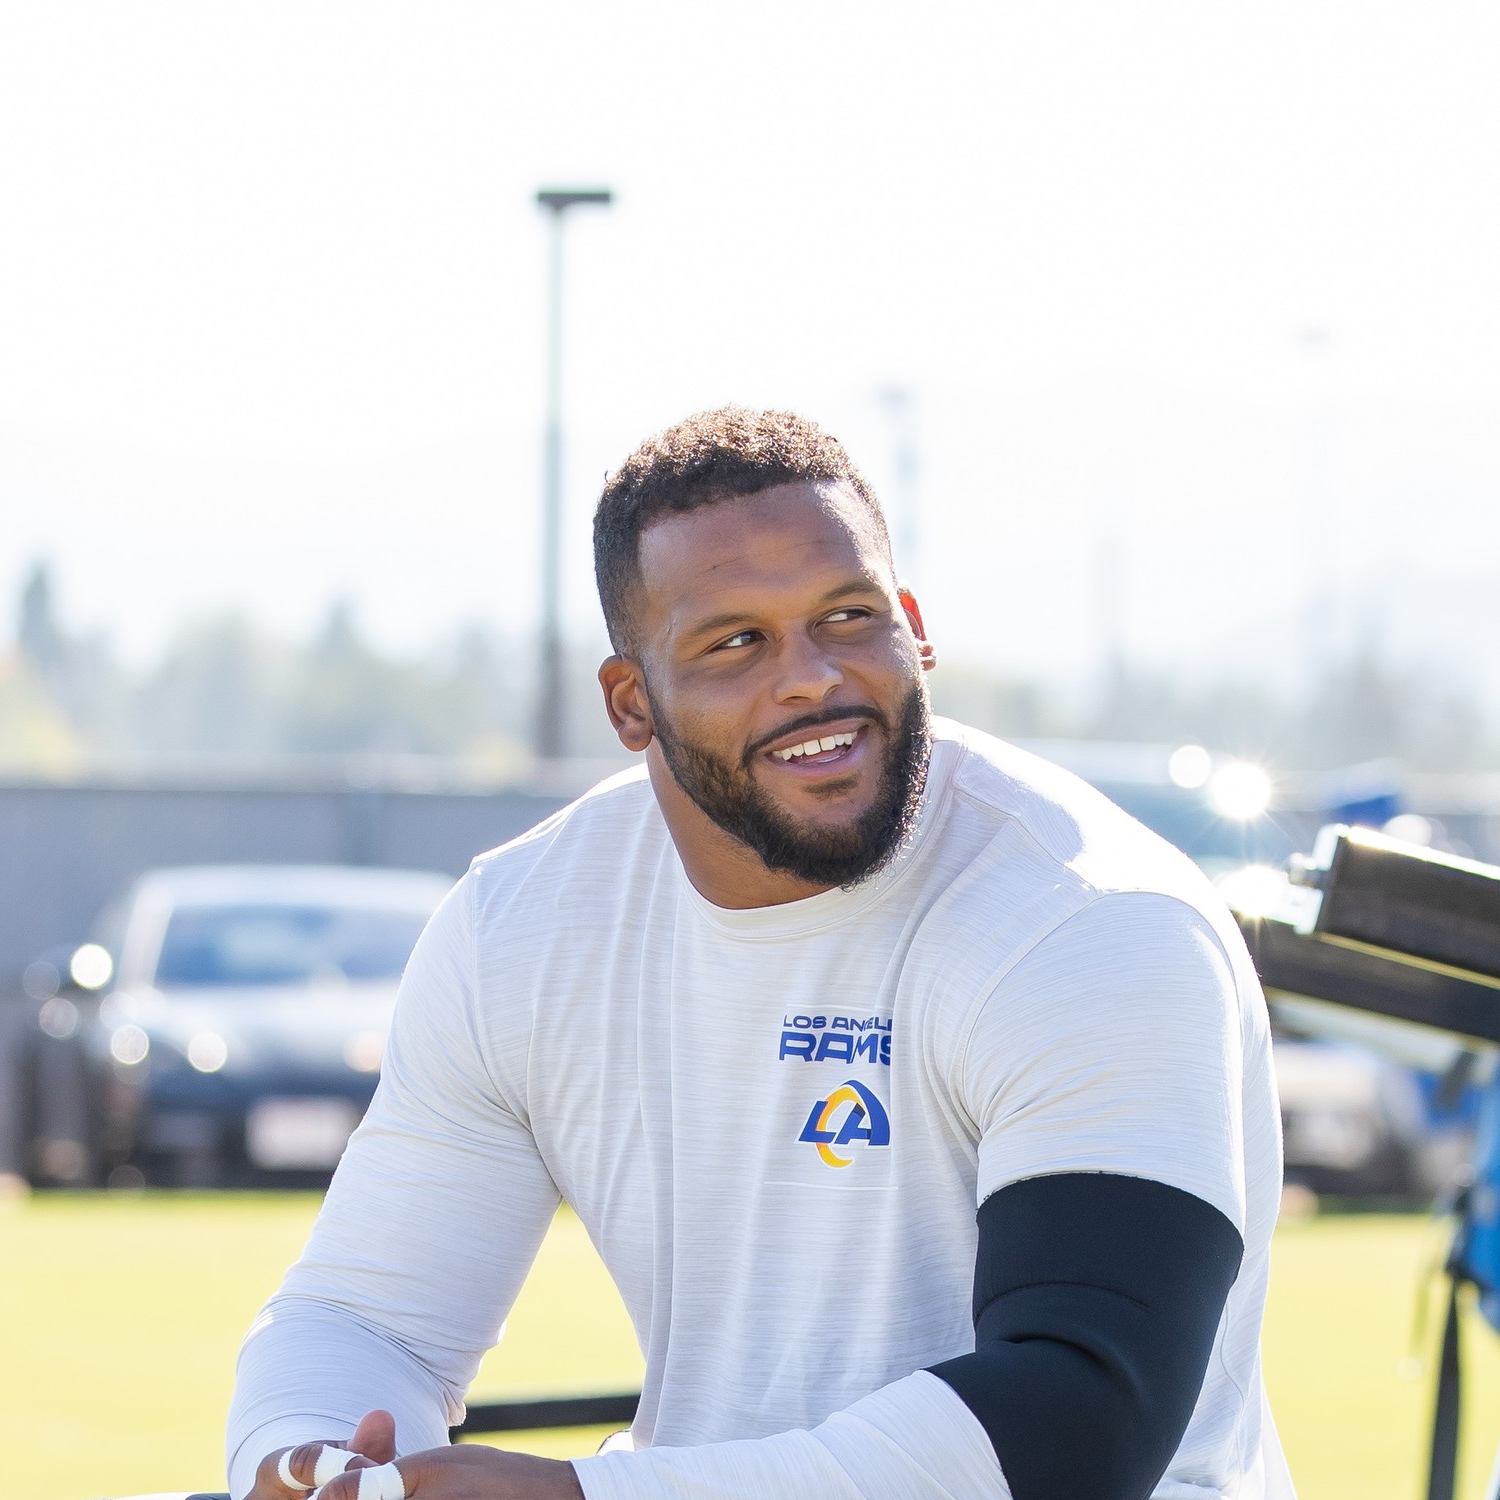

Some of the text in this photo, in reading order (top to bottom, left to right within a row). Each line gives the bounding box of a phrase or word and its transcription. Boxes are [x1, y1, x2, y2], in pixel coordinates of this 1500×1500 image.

[783, 1014, 827, 1029] LOS
[779, 1031, 892, 1066] RAMS
[798, 1079, 891, 1146] LA
